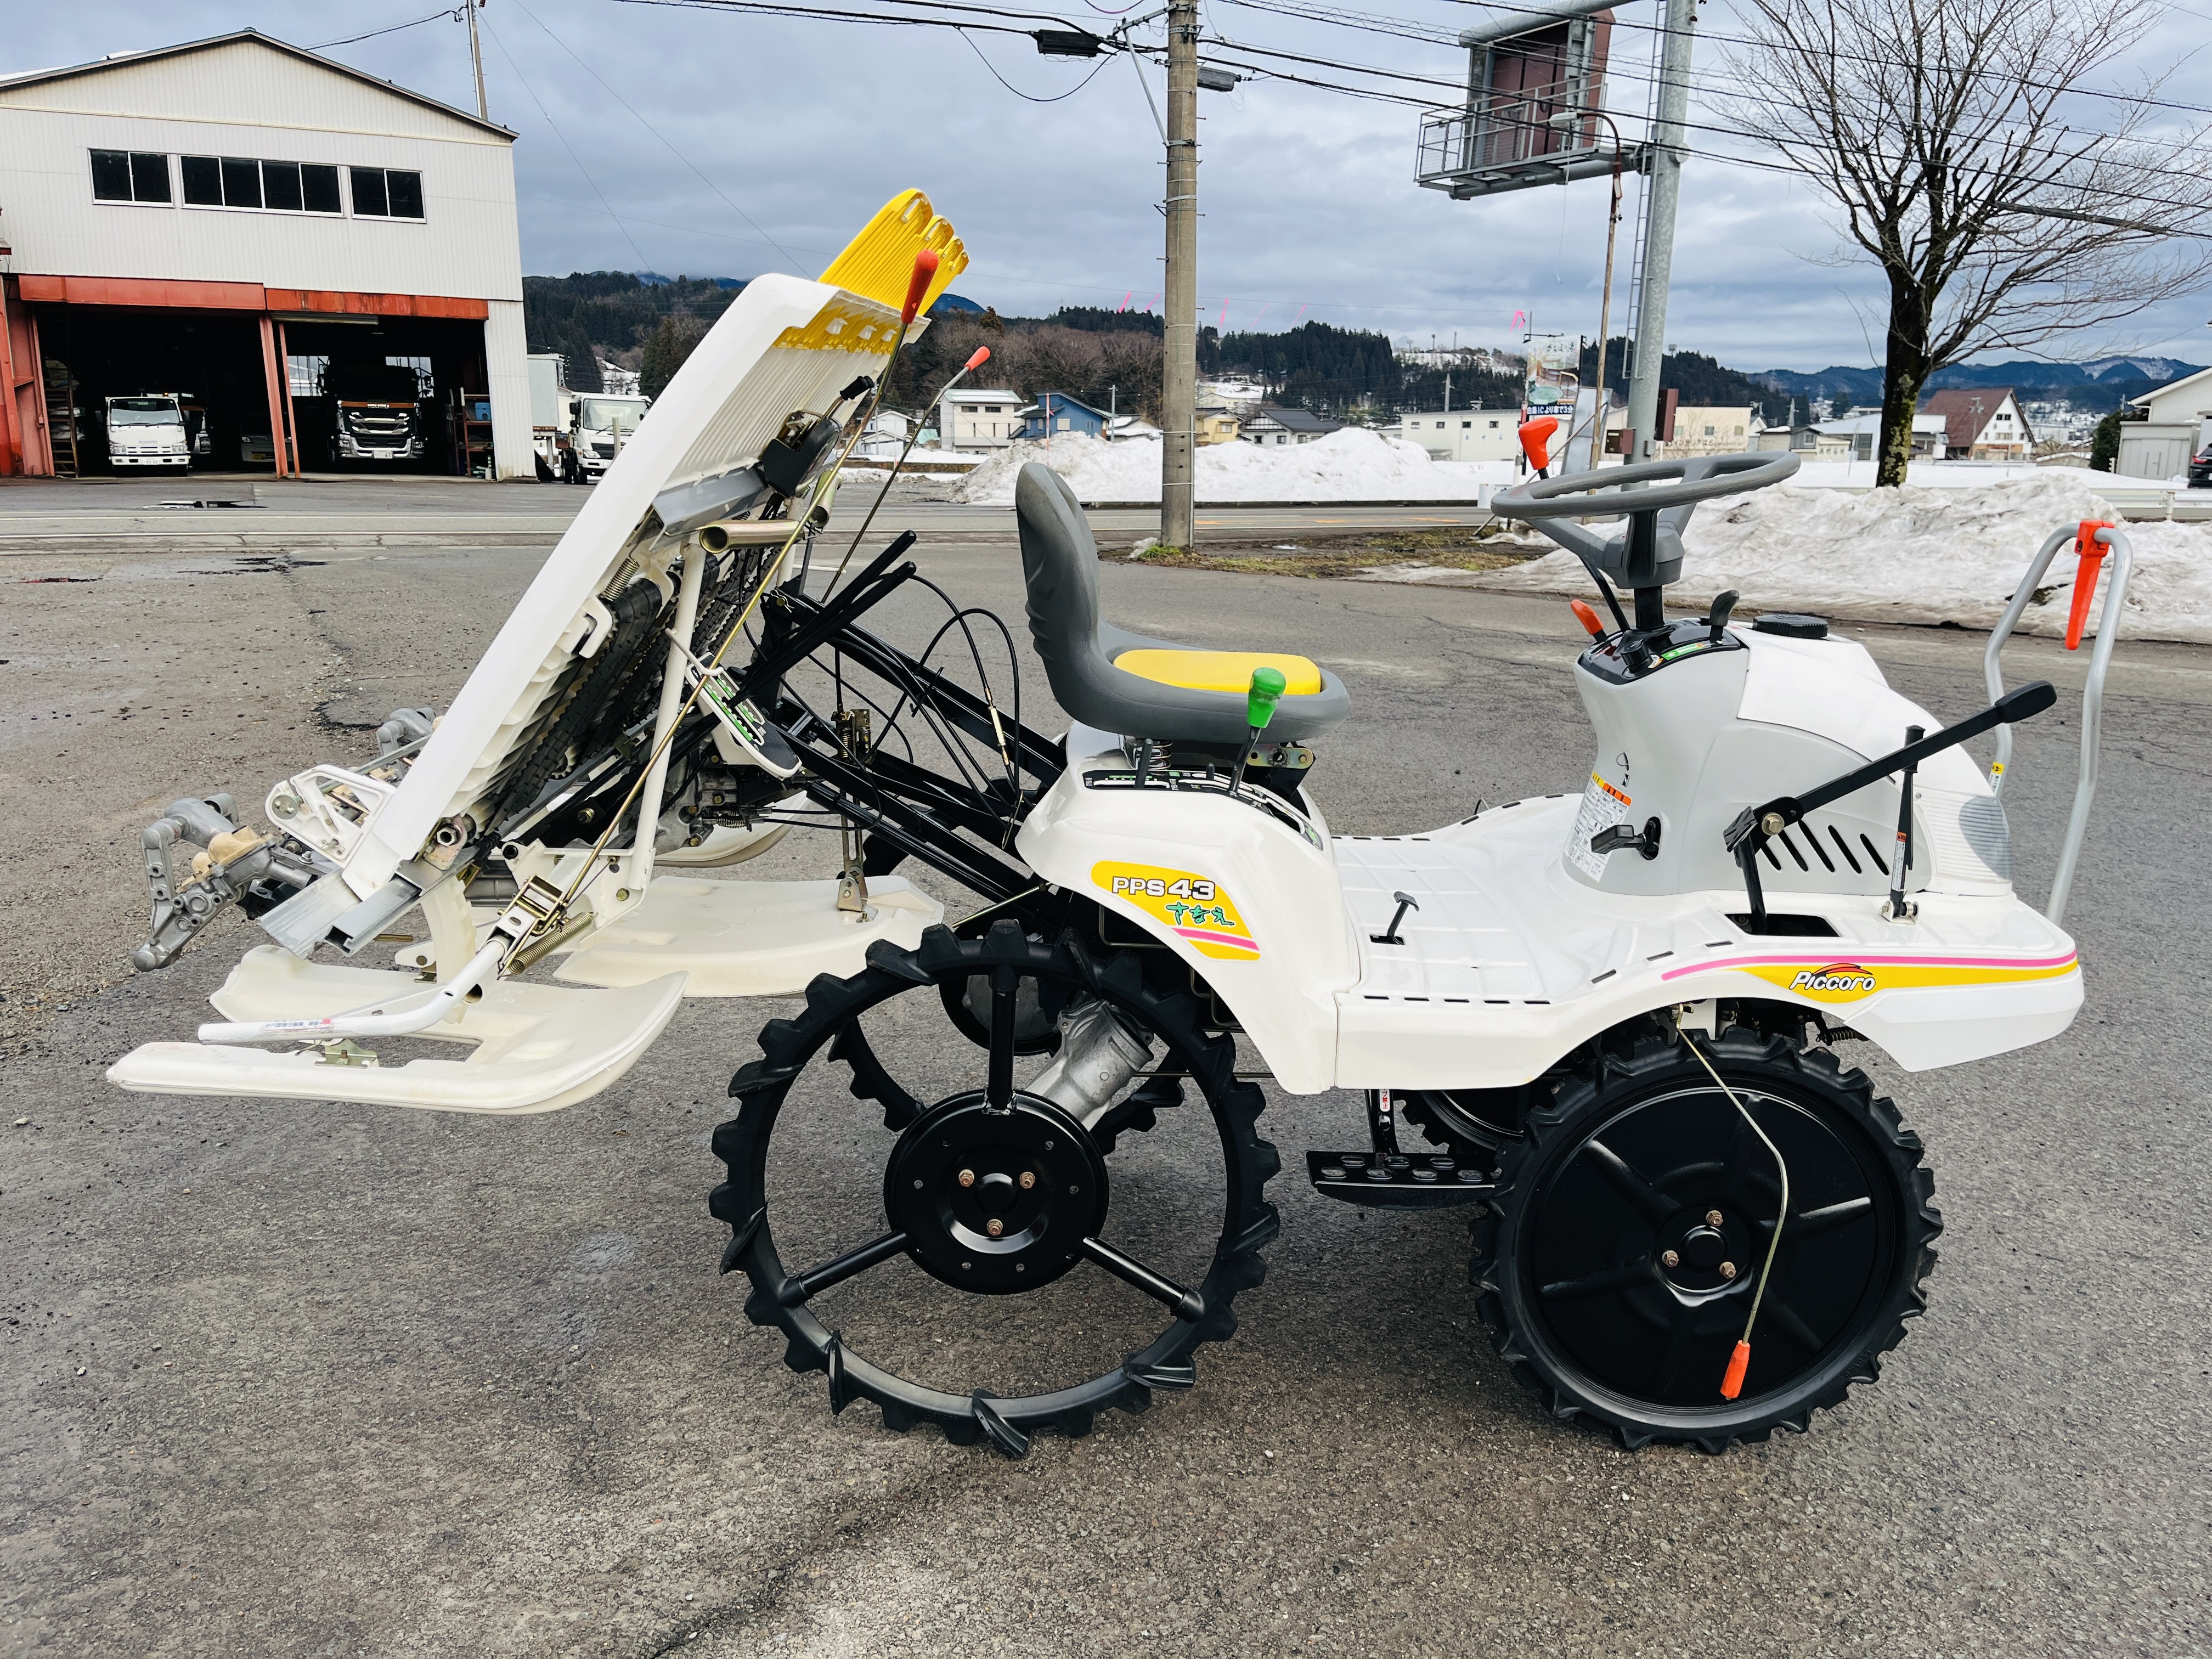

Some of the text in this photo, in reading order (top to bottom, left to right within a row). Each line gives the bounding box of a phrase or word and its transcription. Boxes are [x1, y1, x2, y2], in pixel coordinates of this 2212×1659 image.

[1166, 901, 1235, 926] さなえ
[1789, 970, 1876, 991] Piccoro
